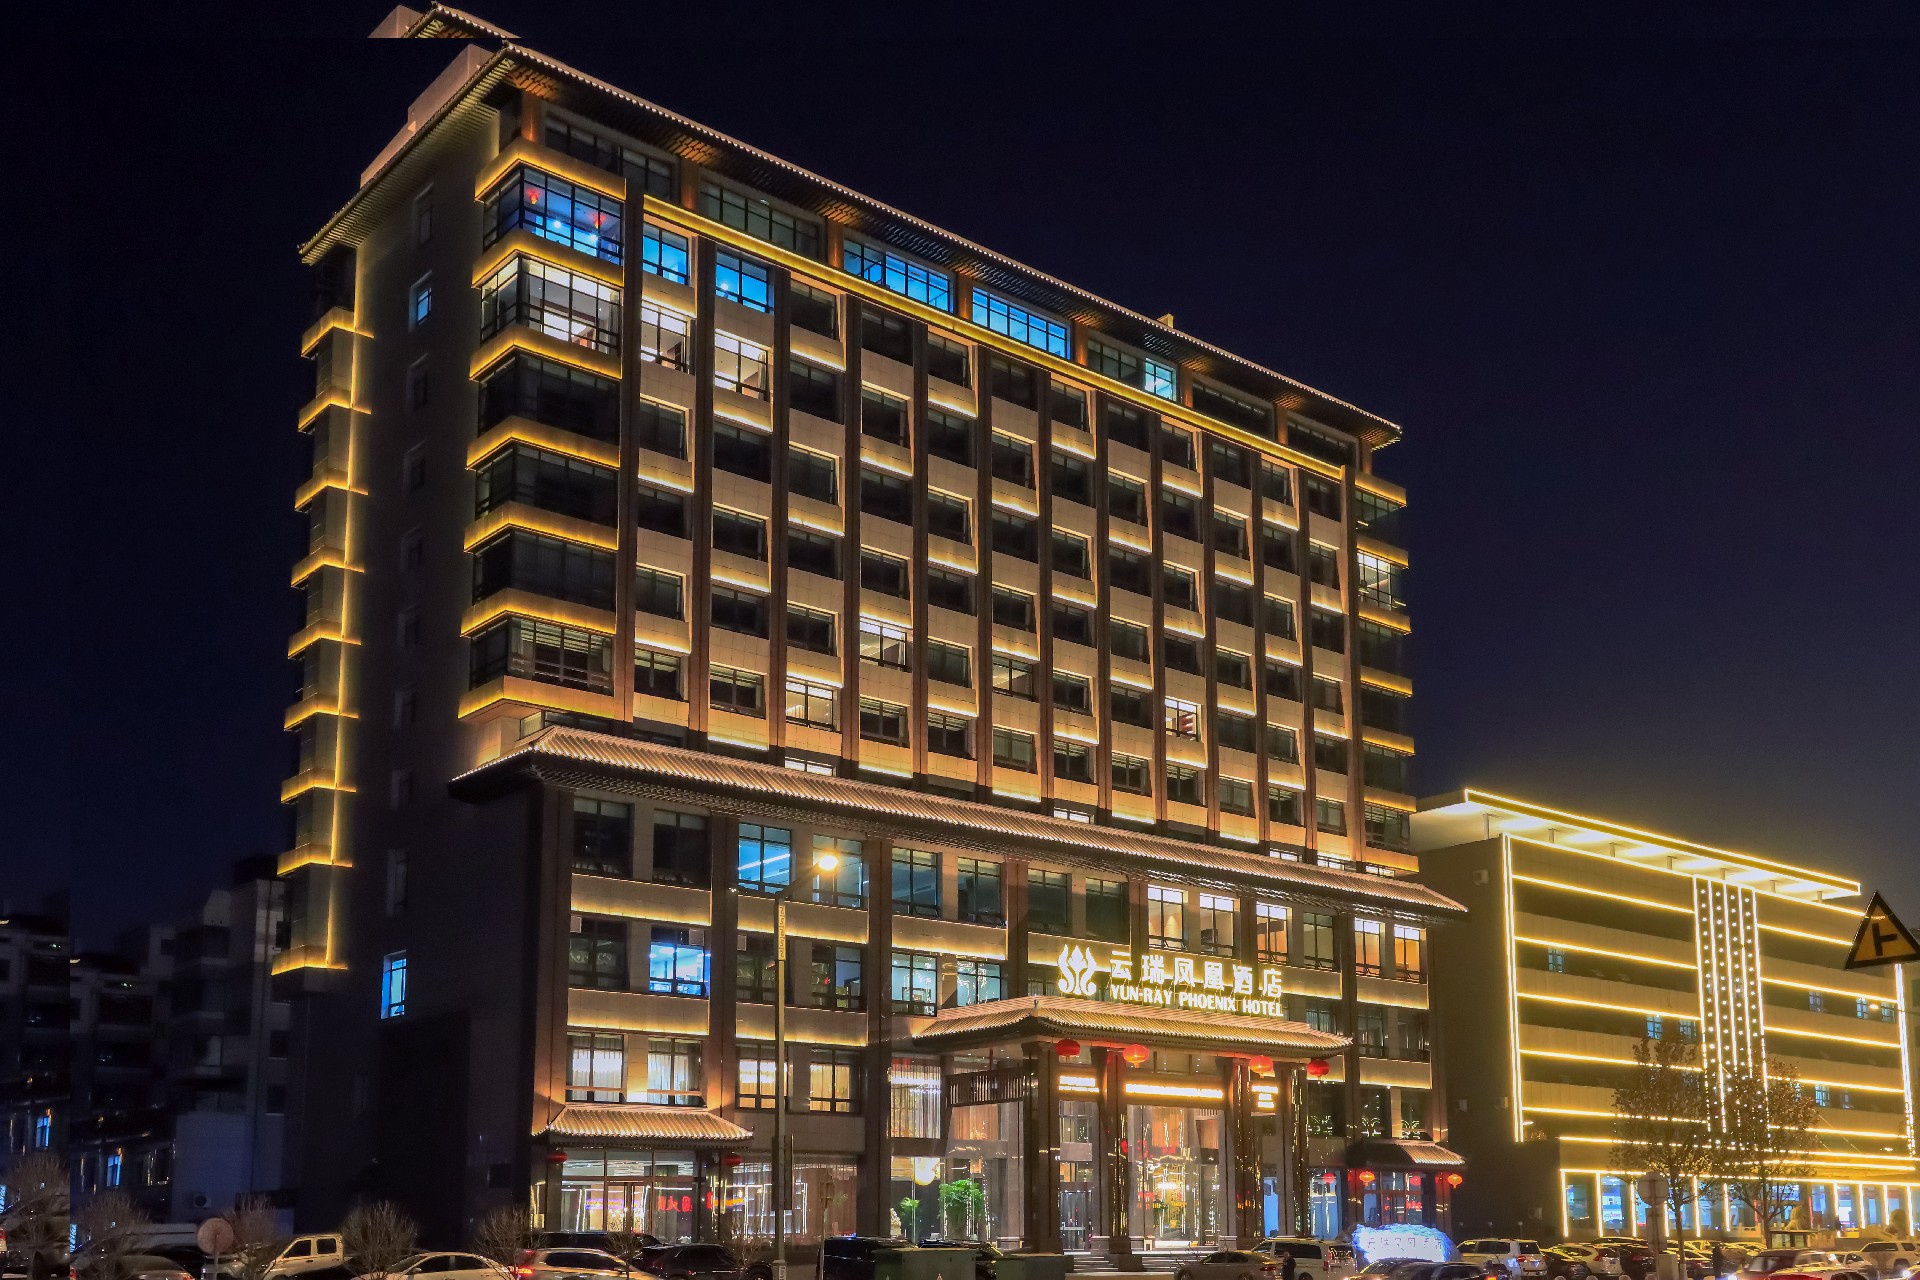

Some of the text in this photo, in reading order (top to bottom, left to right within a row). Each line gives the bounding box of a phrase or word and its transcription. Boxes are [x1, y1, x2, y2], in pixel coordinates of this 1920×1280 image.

[1110, 951, 1282, 998] 云瑞凤凰酒店
[1111, 985, 1283, 1017] YUN-RAY PHOENIX HOTEL
